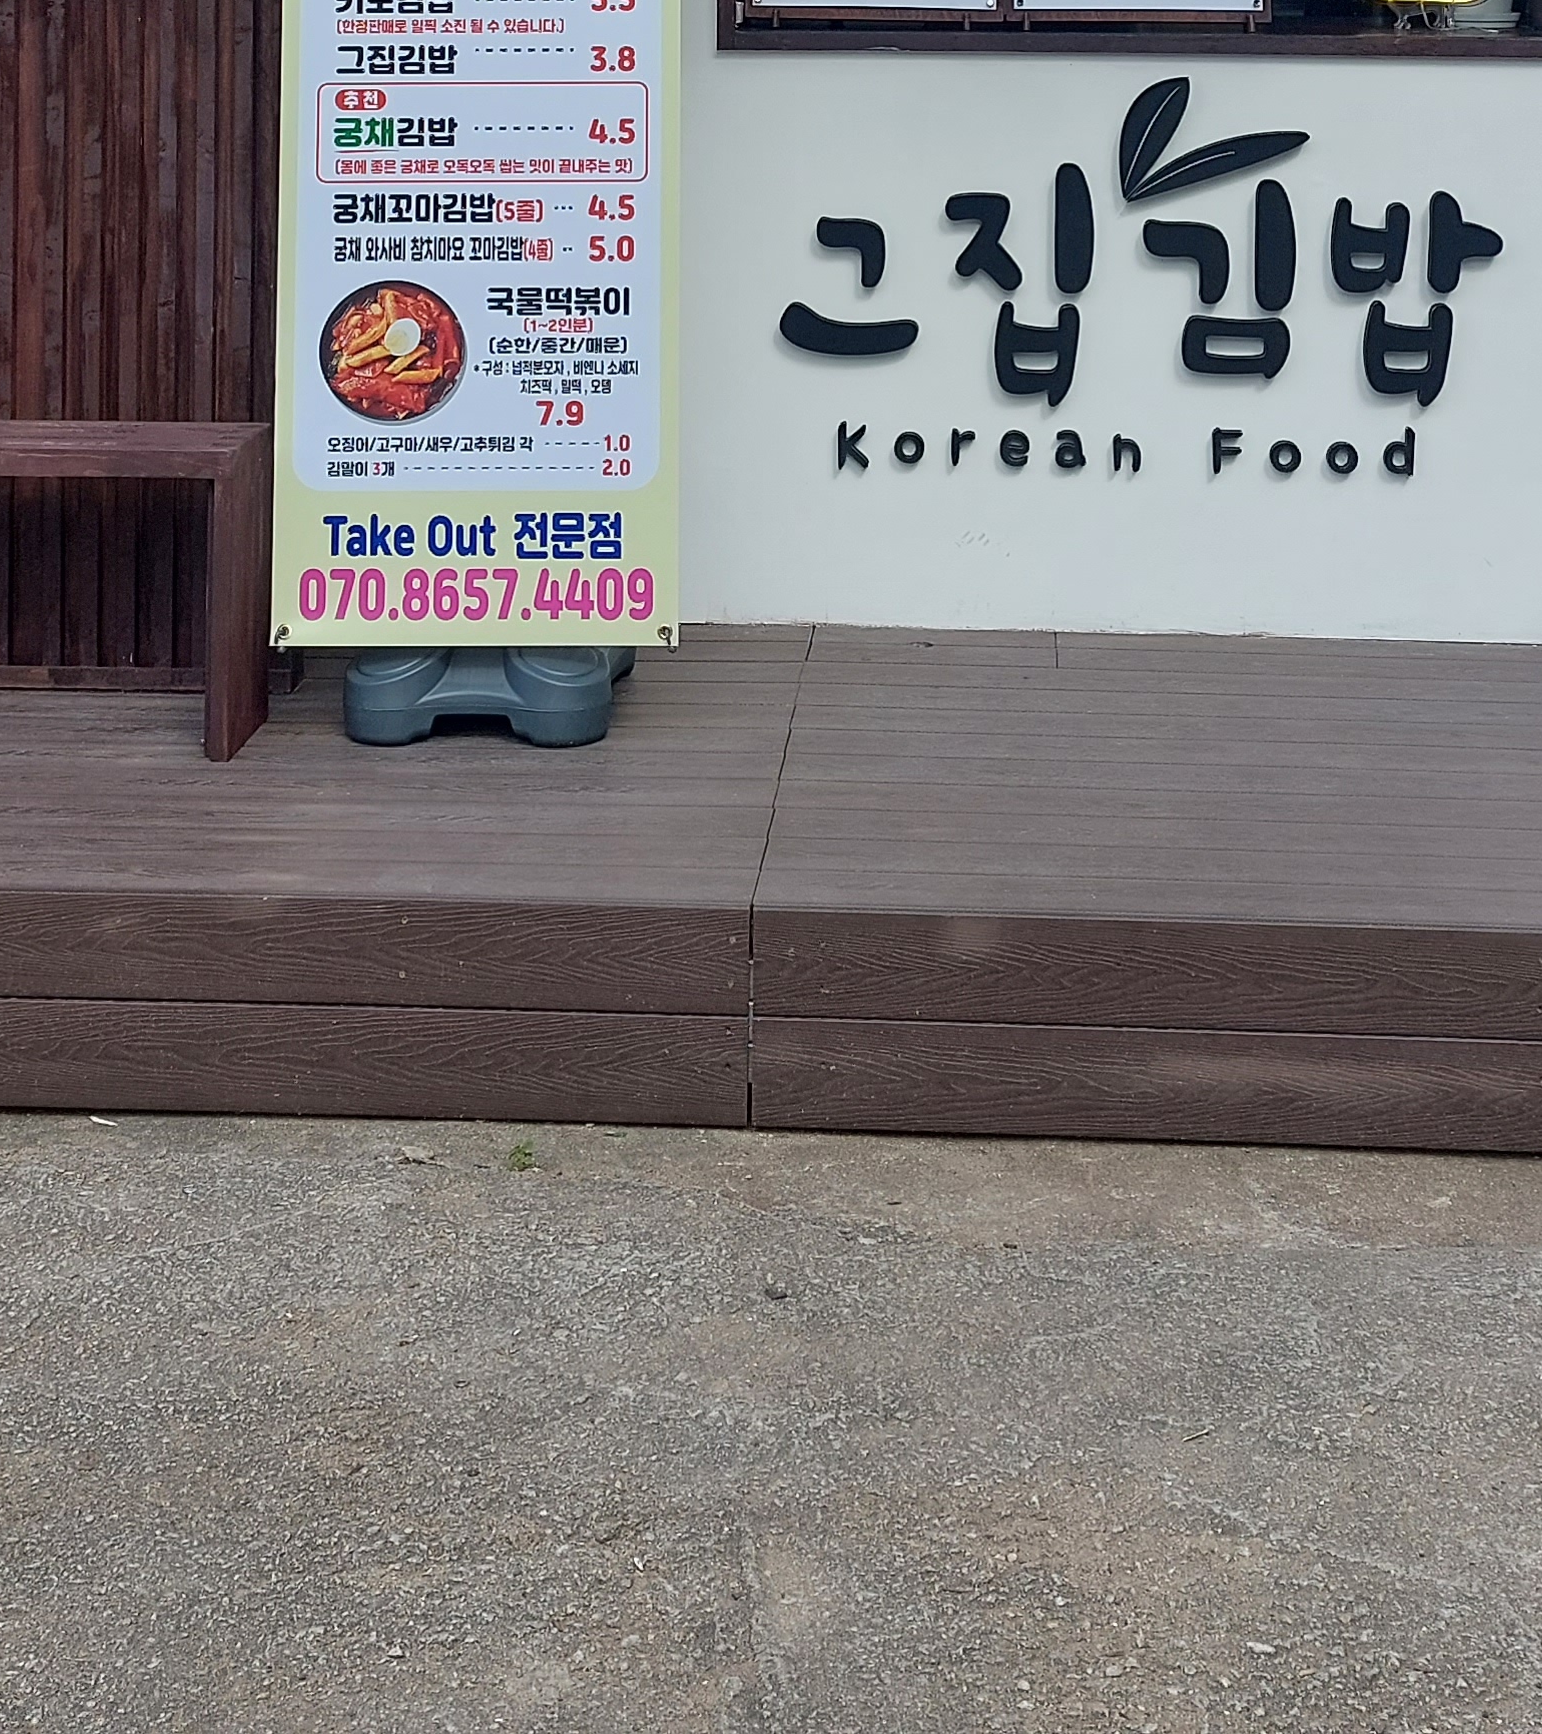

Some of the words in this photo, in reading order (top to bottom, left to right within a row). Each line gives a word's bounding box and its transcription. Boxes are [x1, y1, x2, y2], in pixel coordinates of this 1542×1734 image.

[336, 19, 407, 35] (한정판매로
[411, 19, 437, 34] 일찍
[440, 19, 467, 34] 소진
[470, 19, 484, 34] 될
[487, 19, 500, 34] 수
[335, 44, 457, 75] 그집김밥
[589, 46, 636, 72] 3.8
[343, 91, 379, 109] 추천
[333, 117, 458, 148] 궁채김밥
[588, 118, 636, 144] 4.5
[335, 158, 368, 175] (몸에
[371, 159, 397, 174] 좋은
[401, 159, 439, 174] 궁채로
[443, 159, 495, 174] 오독오독
[500, 159, 524, 174] 씹는
[559, 159, 611, 174] 끝내주는
[614, 158, 633, 175] 맛)
[332, 193, 544, 224] 궁채꼬마김밥(5줄)
[588, 194, 635, 221] 4.5
[333, 236, 361, 262] 궁채
[365, 236, 406, 262] 와사비
[410, 236, 466, 262] 참치마요
[588, 236, 635, 262] 5.0
[779, 162, 1504, 407] 그집김밥
[485, 286, 631, 317] 국물떡볶이
[523, 317, 594, 334] (1~2인분)
[488, 336, 628, 355] (순한/중간/매운)
[607, 360, 639, 376] 소세지
[590, 379, 612, 395] 오뎅
[535, 400, 585, 427] 7.9
[327, 436, 516, 453] 오징어/고구마/새우/고추튀김
[519, 436, 534, 452] 각
[603, 435, 631, 452] 1.0
[837, 421, 1142, 471] Korean
[1212, 427, 1416, 477] Food
[327, 461, 368, 477] 김말이
[602, 459, 631, 476] 2.0
[323, 515, 415, 557] Take
[427, 515, 496, 557] Out
[514, 512, 622, 560] 전문점
[298, 568, 654, 621] 070.8657.4409
